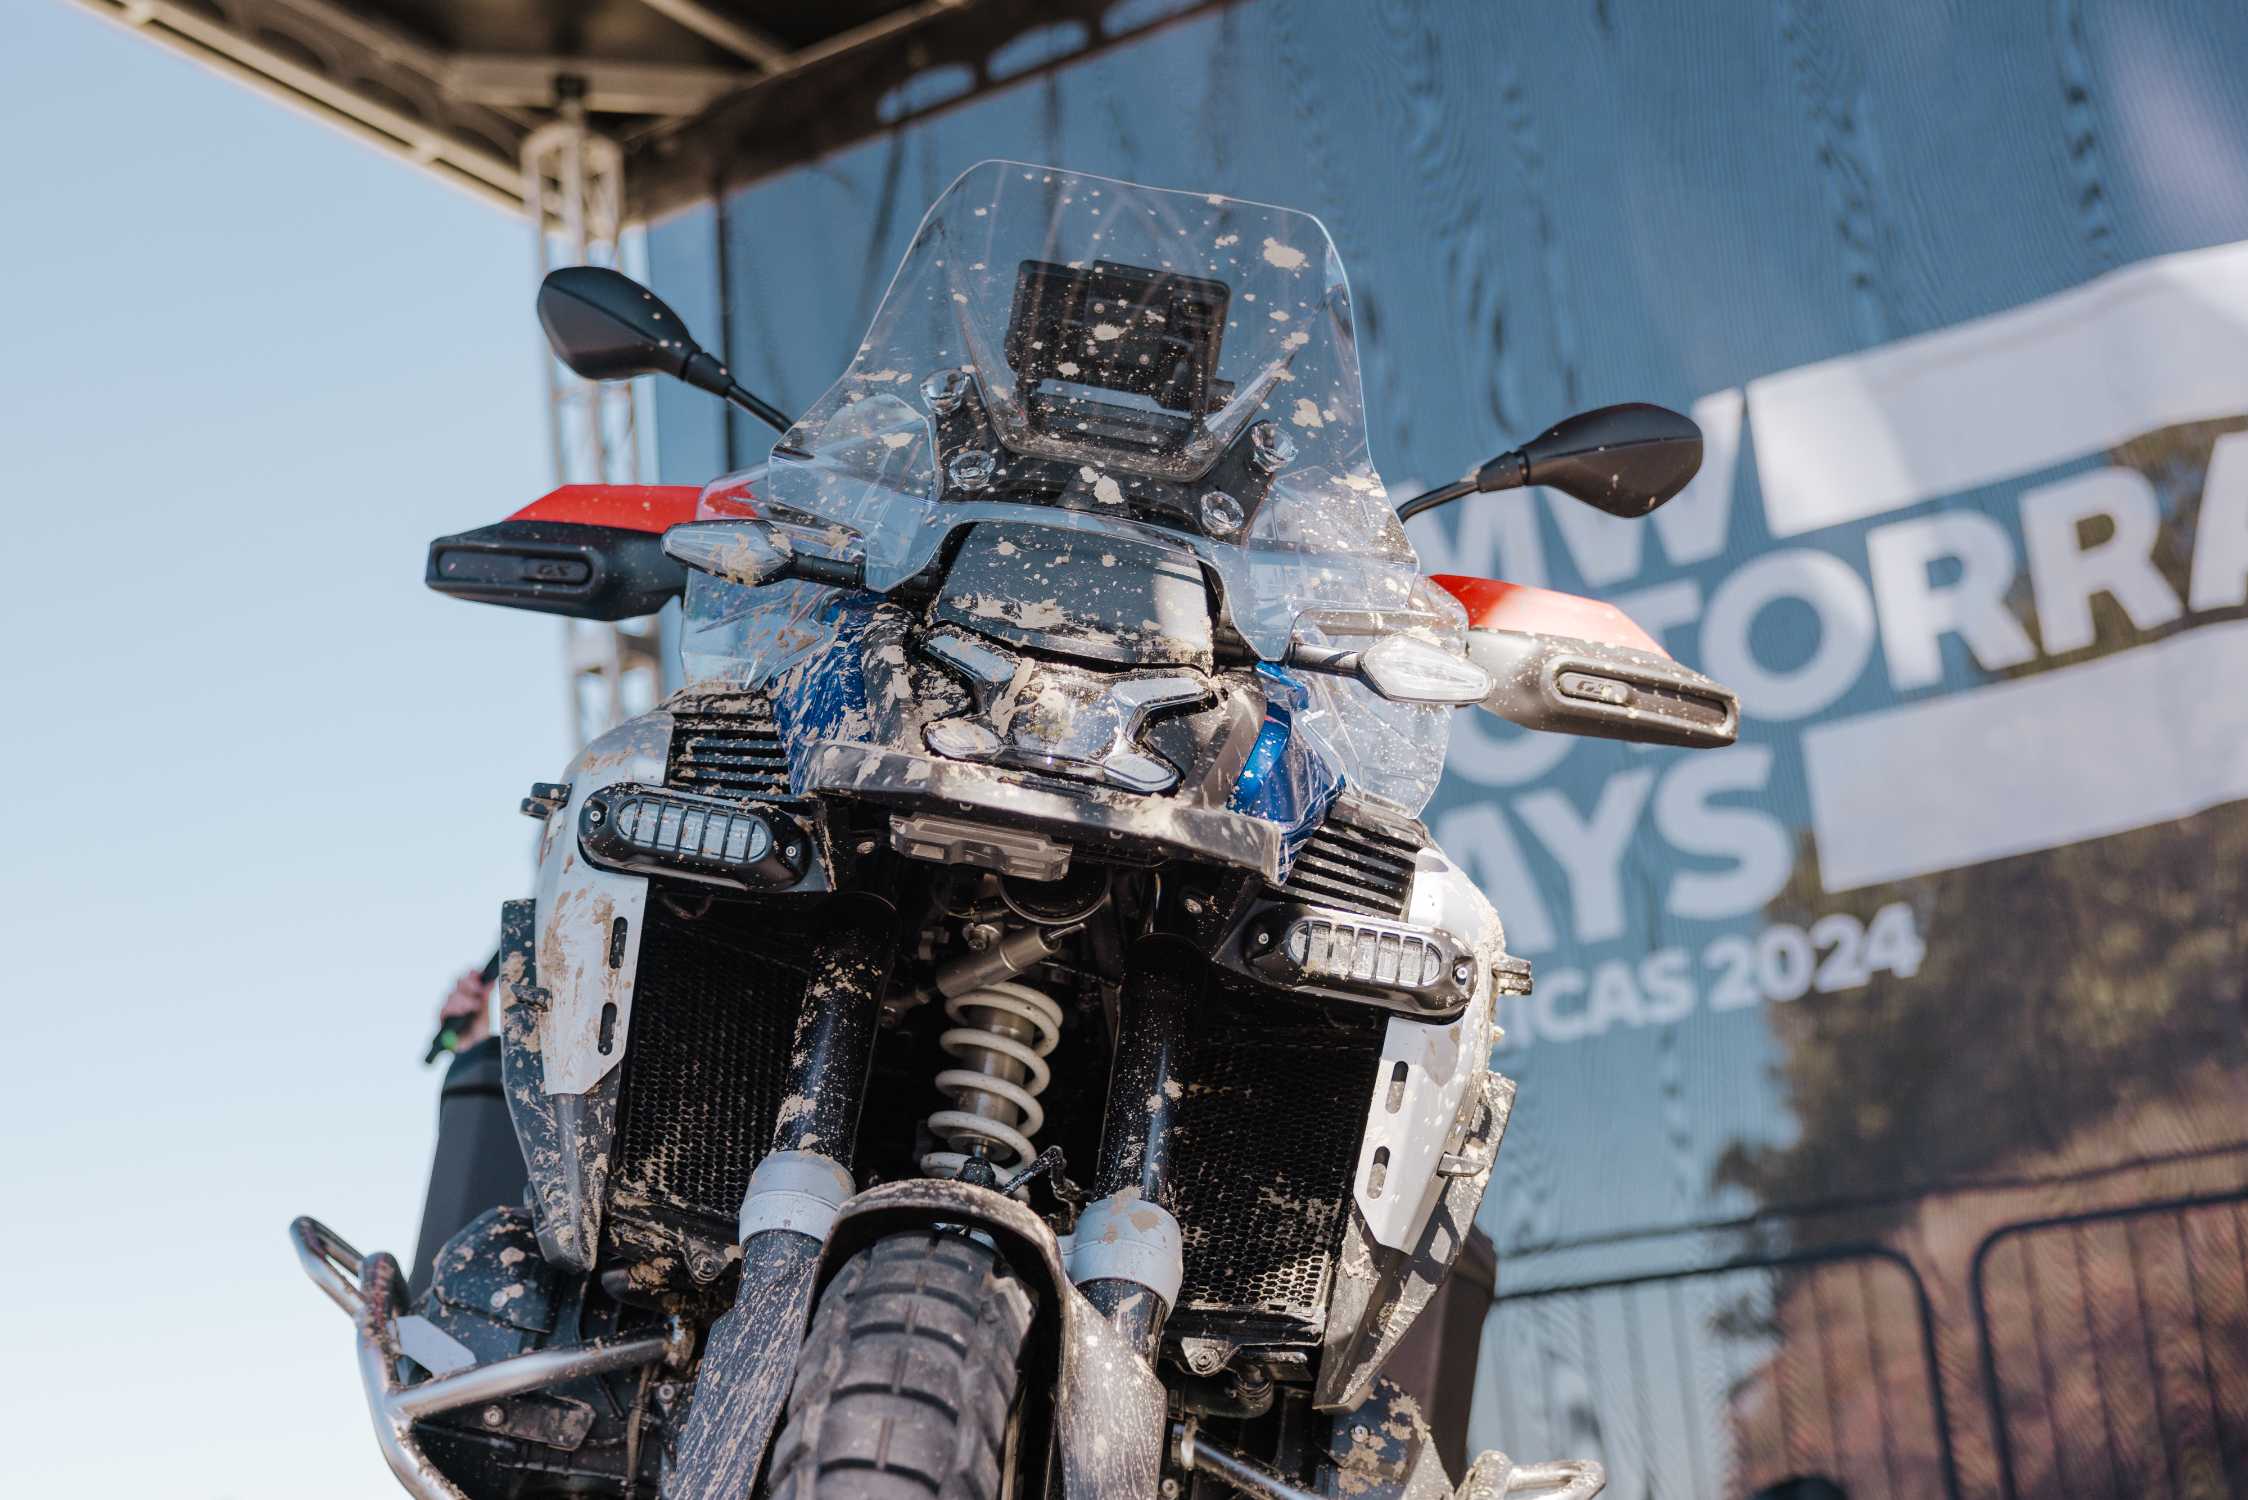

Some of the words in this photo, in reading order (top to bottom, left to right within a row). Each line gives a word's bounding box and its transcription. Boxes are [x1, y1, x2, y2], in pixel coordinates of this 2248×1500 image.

[1386, 386, 1744, 590] MW
[1437, 745, 1793, 952] AYS
[1500, 948, 1695, 1050] ICAS
[1704, 903, 1925, 1012] 2024
